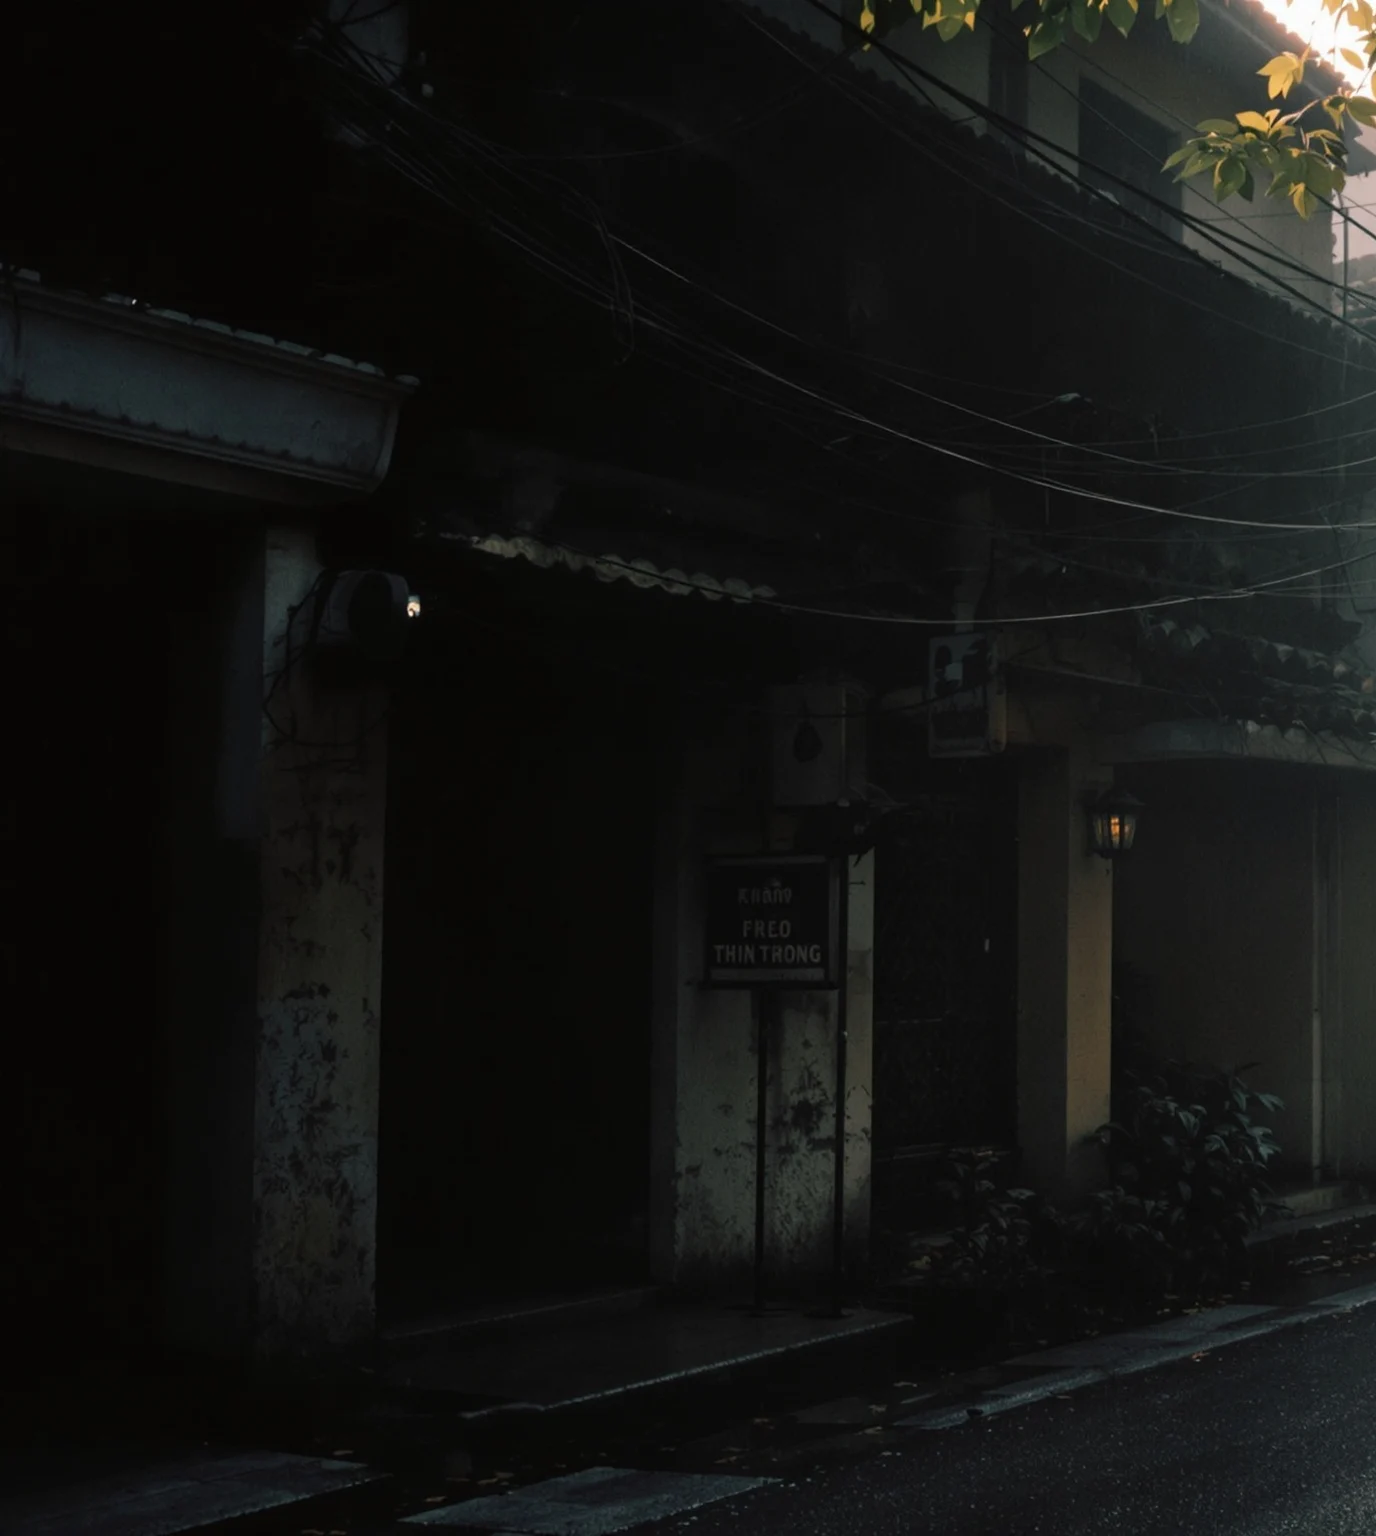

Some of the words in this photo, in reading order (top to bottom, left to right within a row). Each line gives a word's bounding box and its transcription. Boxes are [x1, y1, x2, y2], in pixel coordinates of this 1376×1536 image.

[743, 919, 791, 938] FREO
[713, 945, 755, 964] THIN
[759, 944, 821, 964] TRONG
